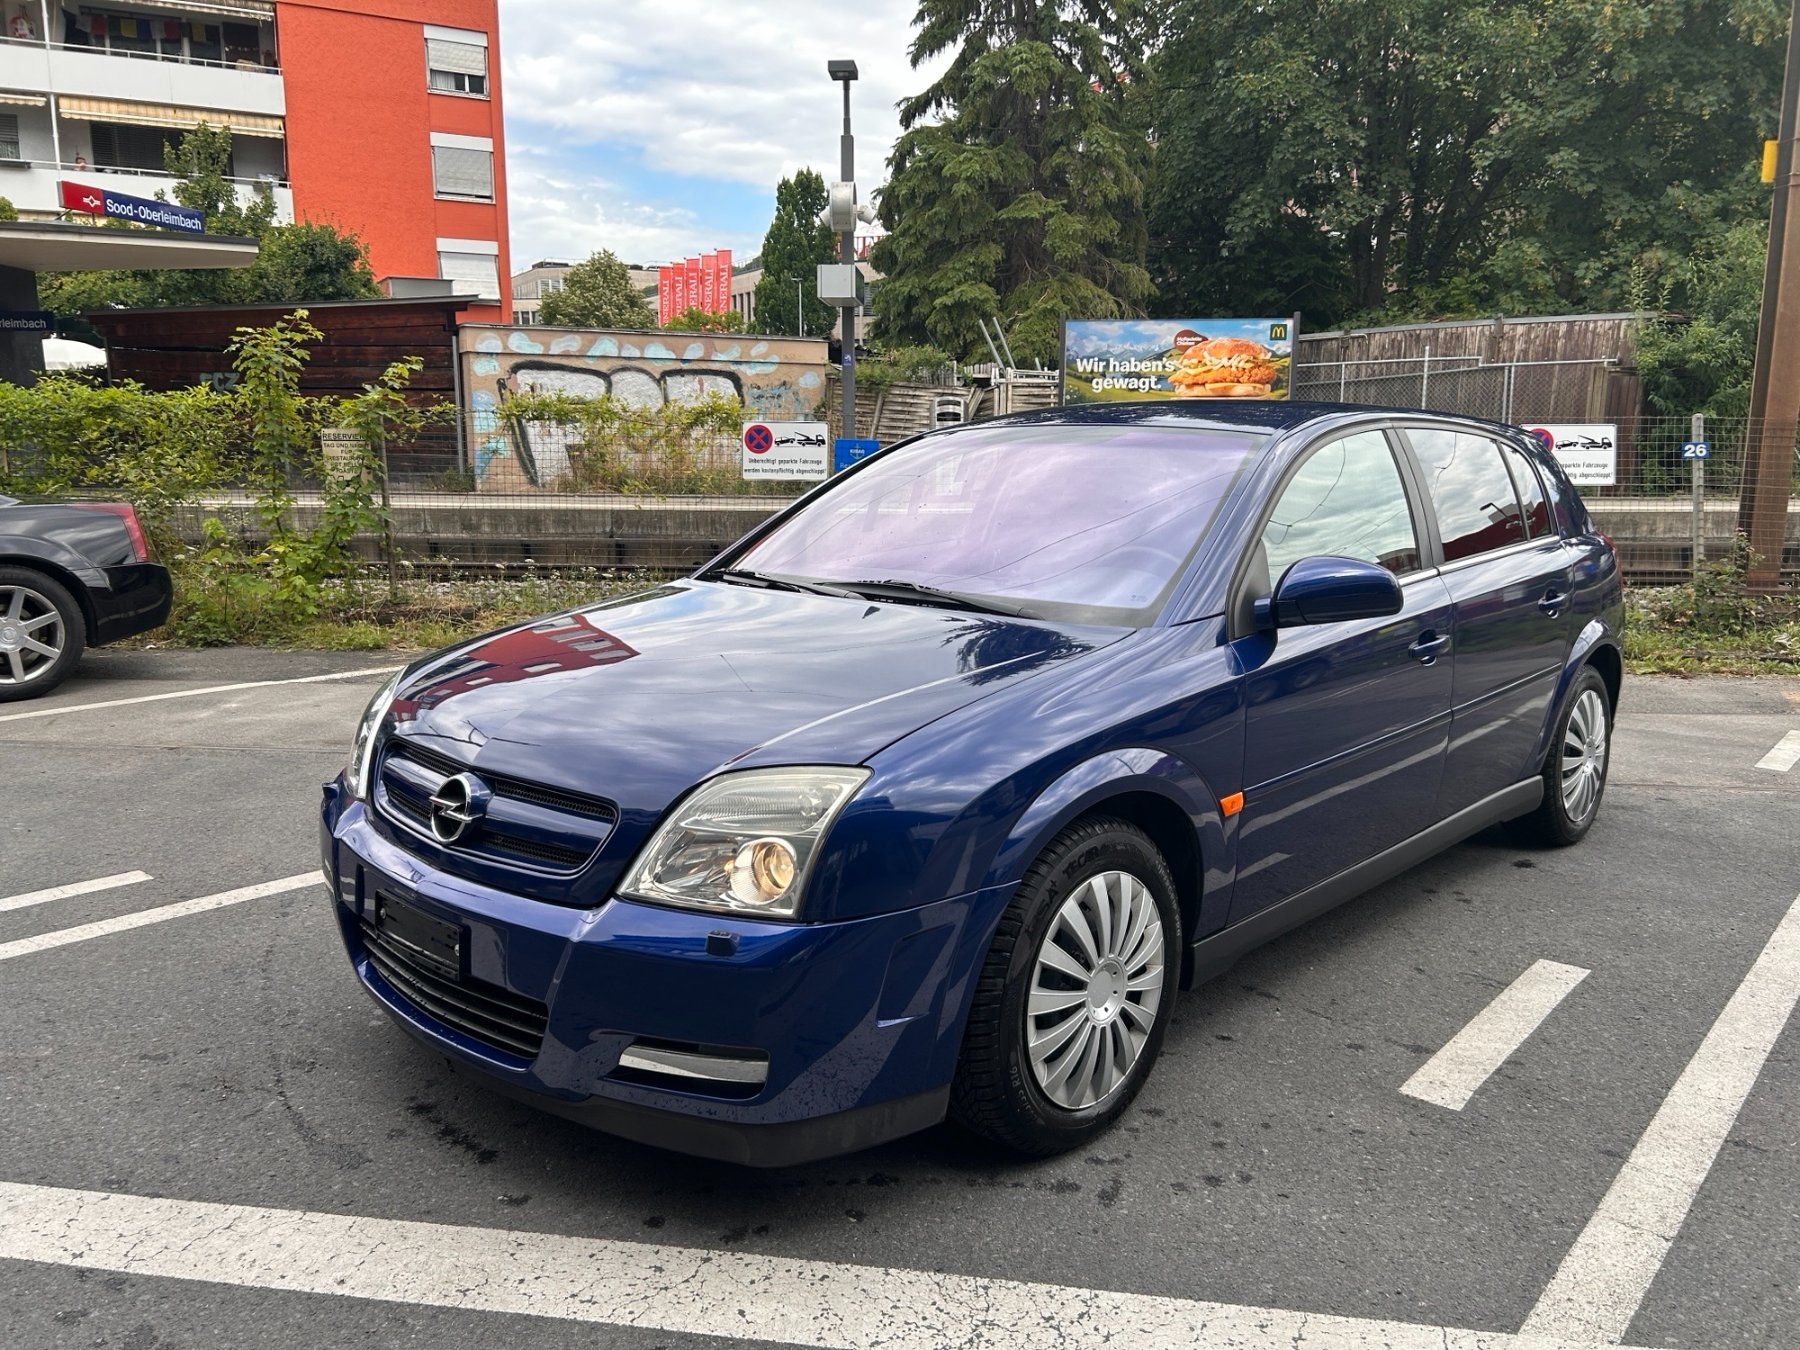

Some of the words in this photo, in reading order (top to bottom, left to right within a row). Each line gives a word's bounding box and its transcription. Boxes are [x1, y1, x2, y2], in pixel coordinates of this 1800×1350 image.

[106, 199, 202, 231] Sood-Oberleimbach
[1076, 358, 1107, 373] Wir
[1109, 357, 1175, 373] haben's
[1091, 376, 1162, 394] gewagt.
[1684, 445, 1707, 457] 26
[799, 458, 822, 466] Fahrzeuge
[1582, 461, 1608, 470] Fahrzeuge
